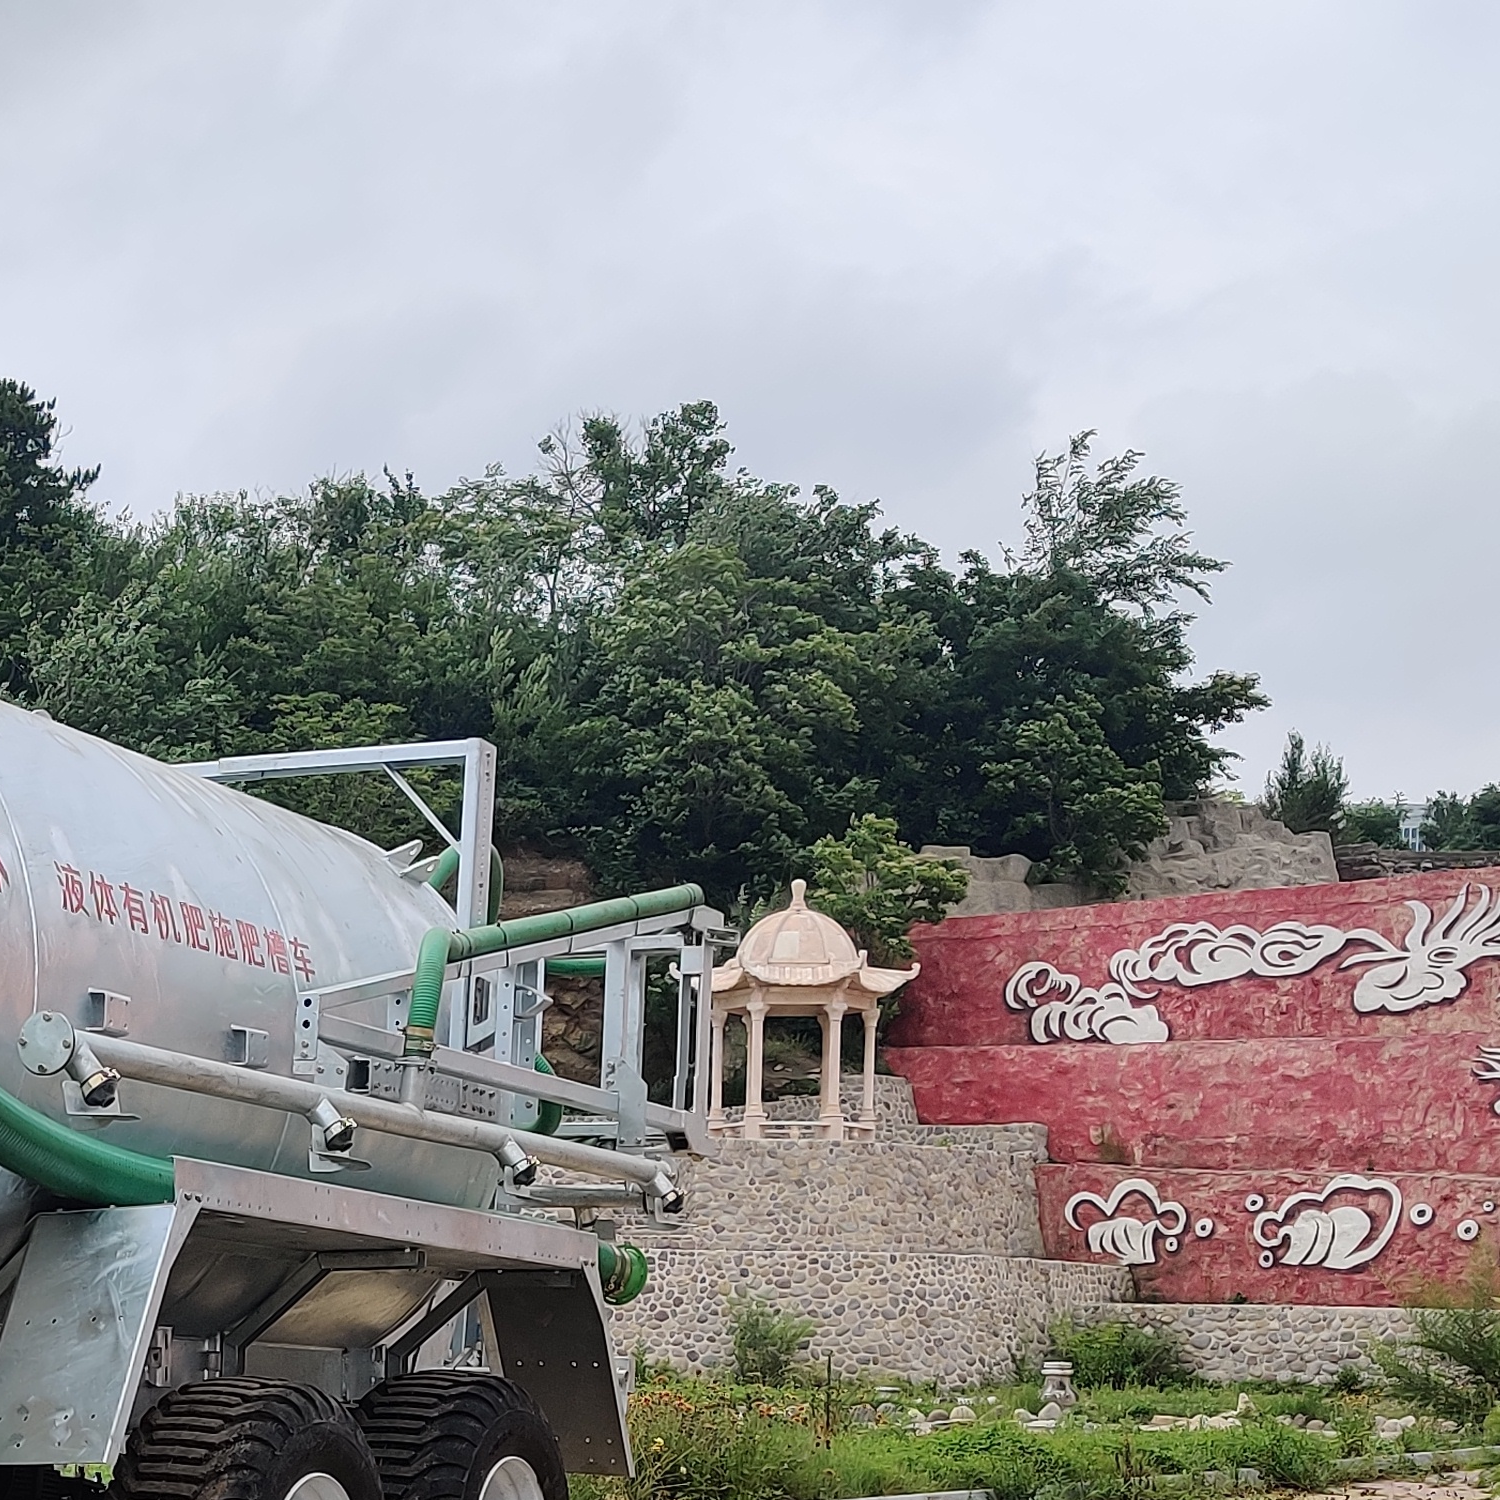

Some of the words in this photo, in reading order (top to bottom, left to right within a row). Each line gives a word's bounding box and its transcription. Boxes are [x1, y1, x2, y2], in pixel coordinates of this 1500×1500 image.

[53, 860, 316, 983] 液体有机肥施肥槽车
